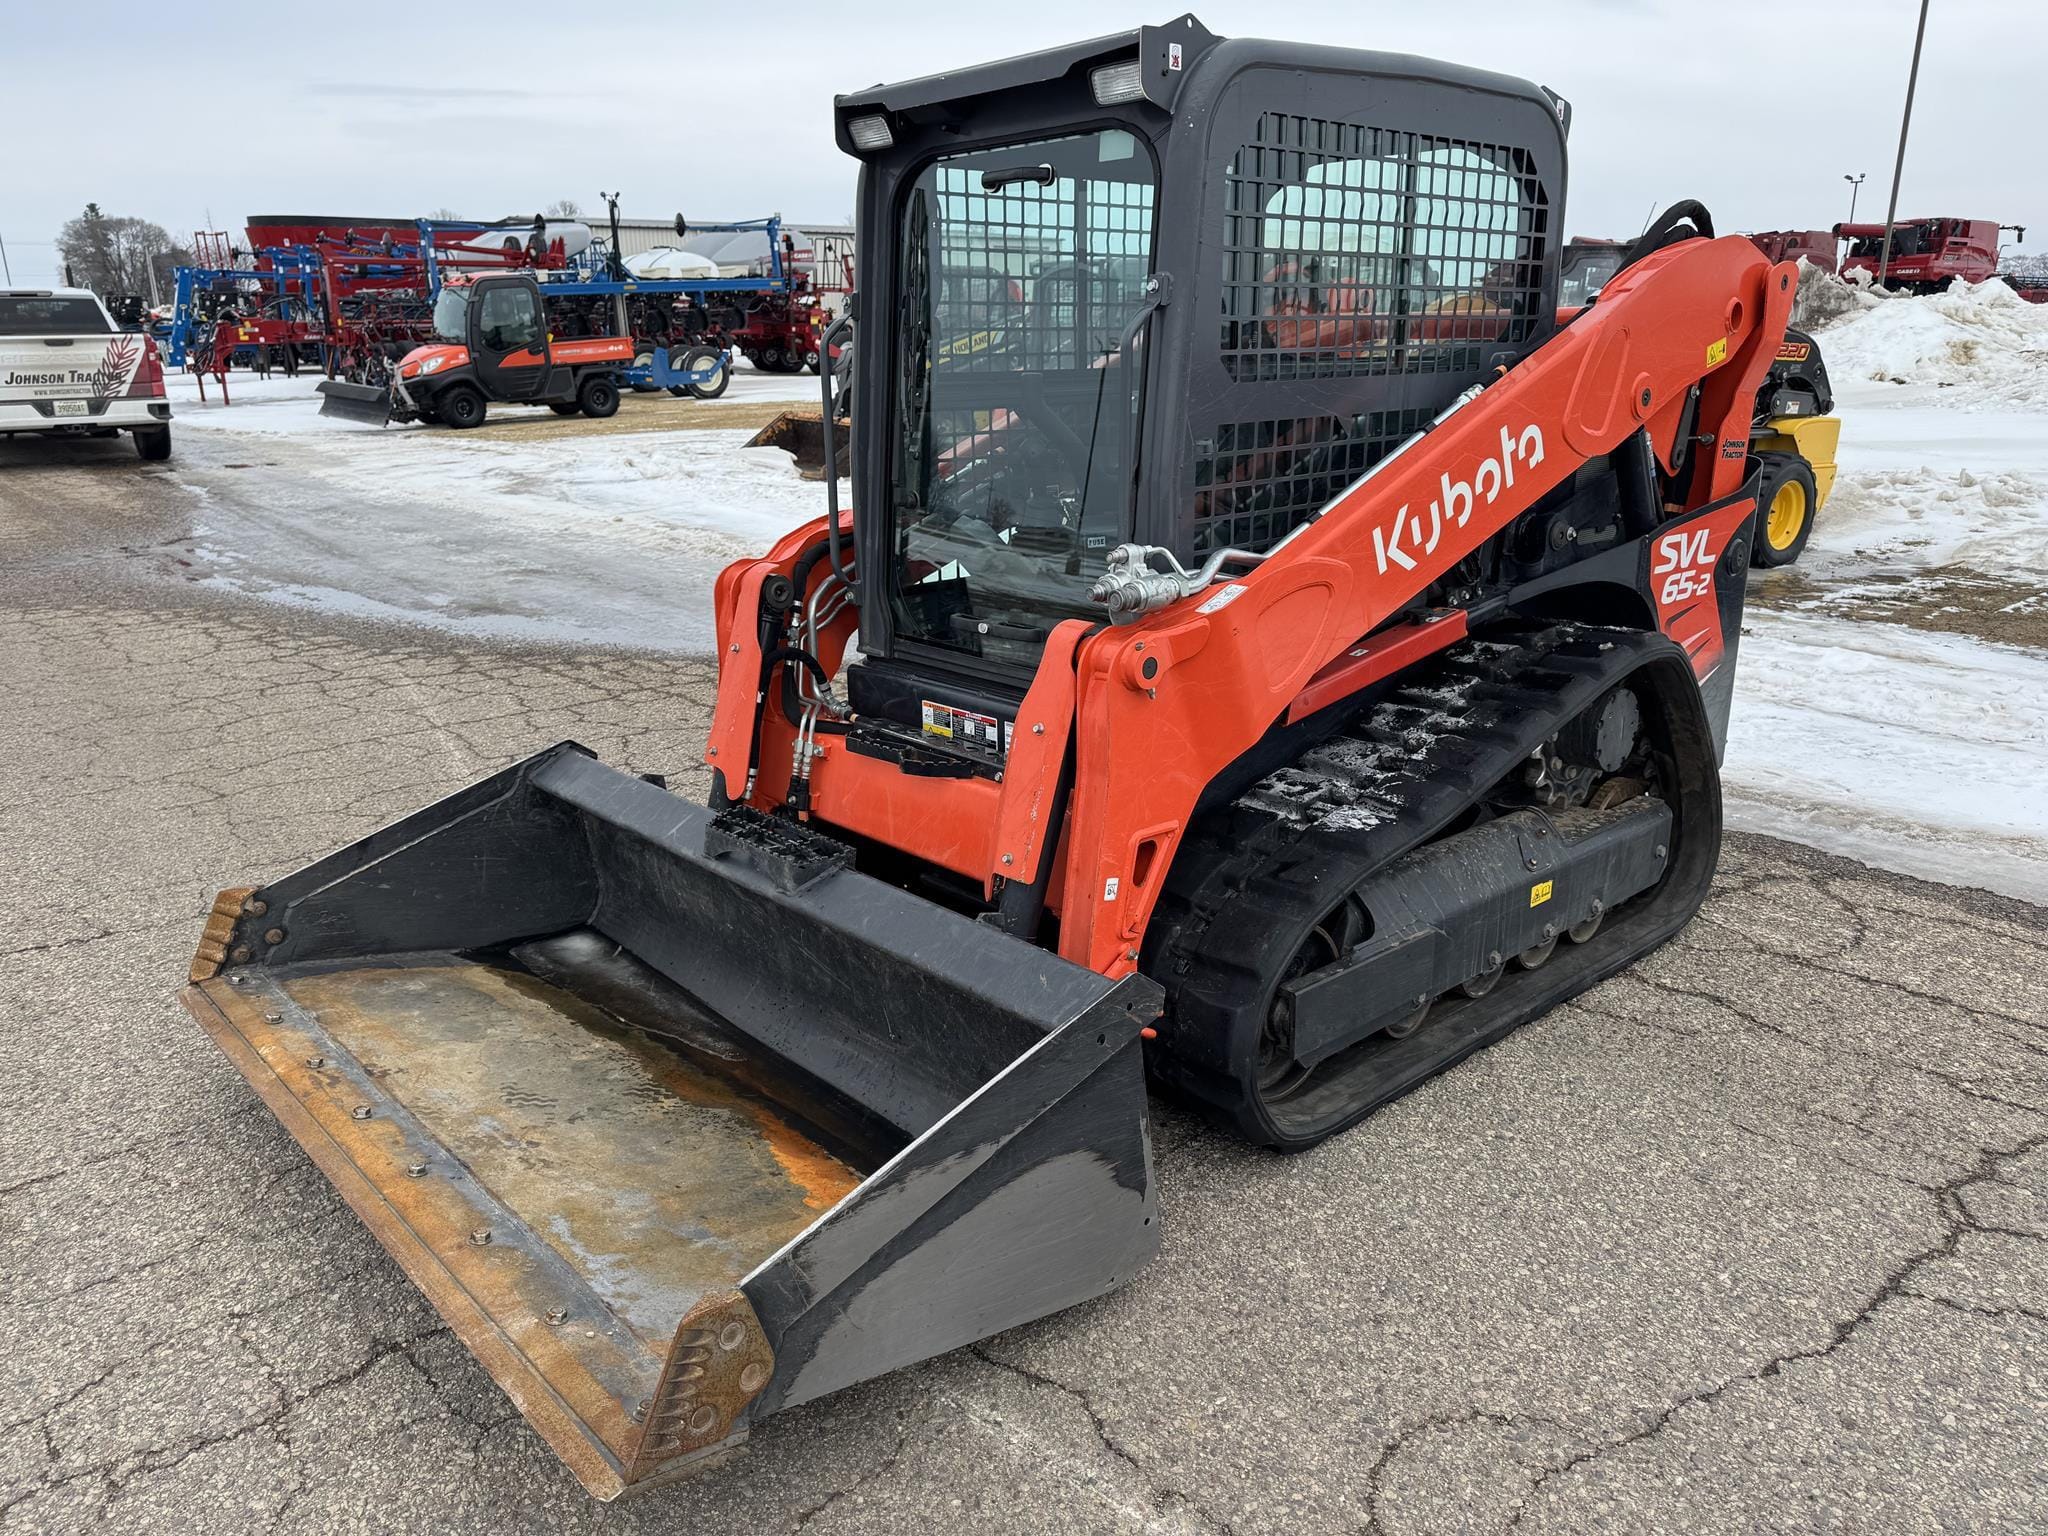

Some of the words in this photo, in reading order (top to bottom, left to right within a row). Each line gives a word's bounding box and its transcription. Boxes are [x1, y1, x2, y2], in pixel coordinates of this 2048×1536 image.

[5, 371, 65, 385] JOHNSON
[1372, 424, 1545, 576] Kubota
[1654, 528, 1717, 575] SVL
[1661, 569, 1711, 605] 65-2
